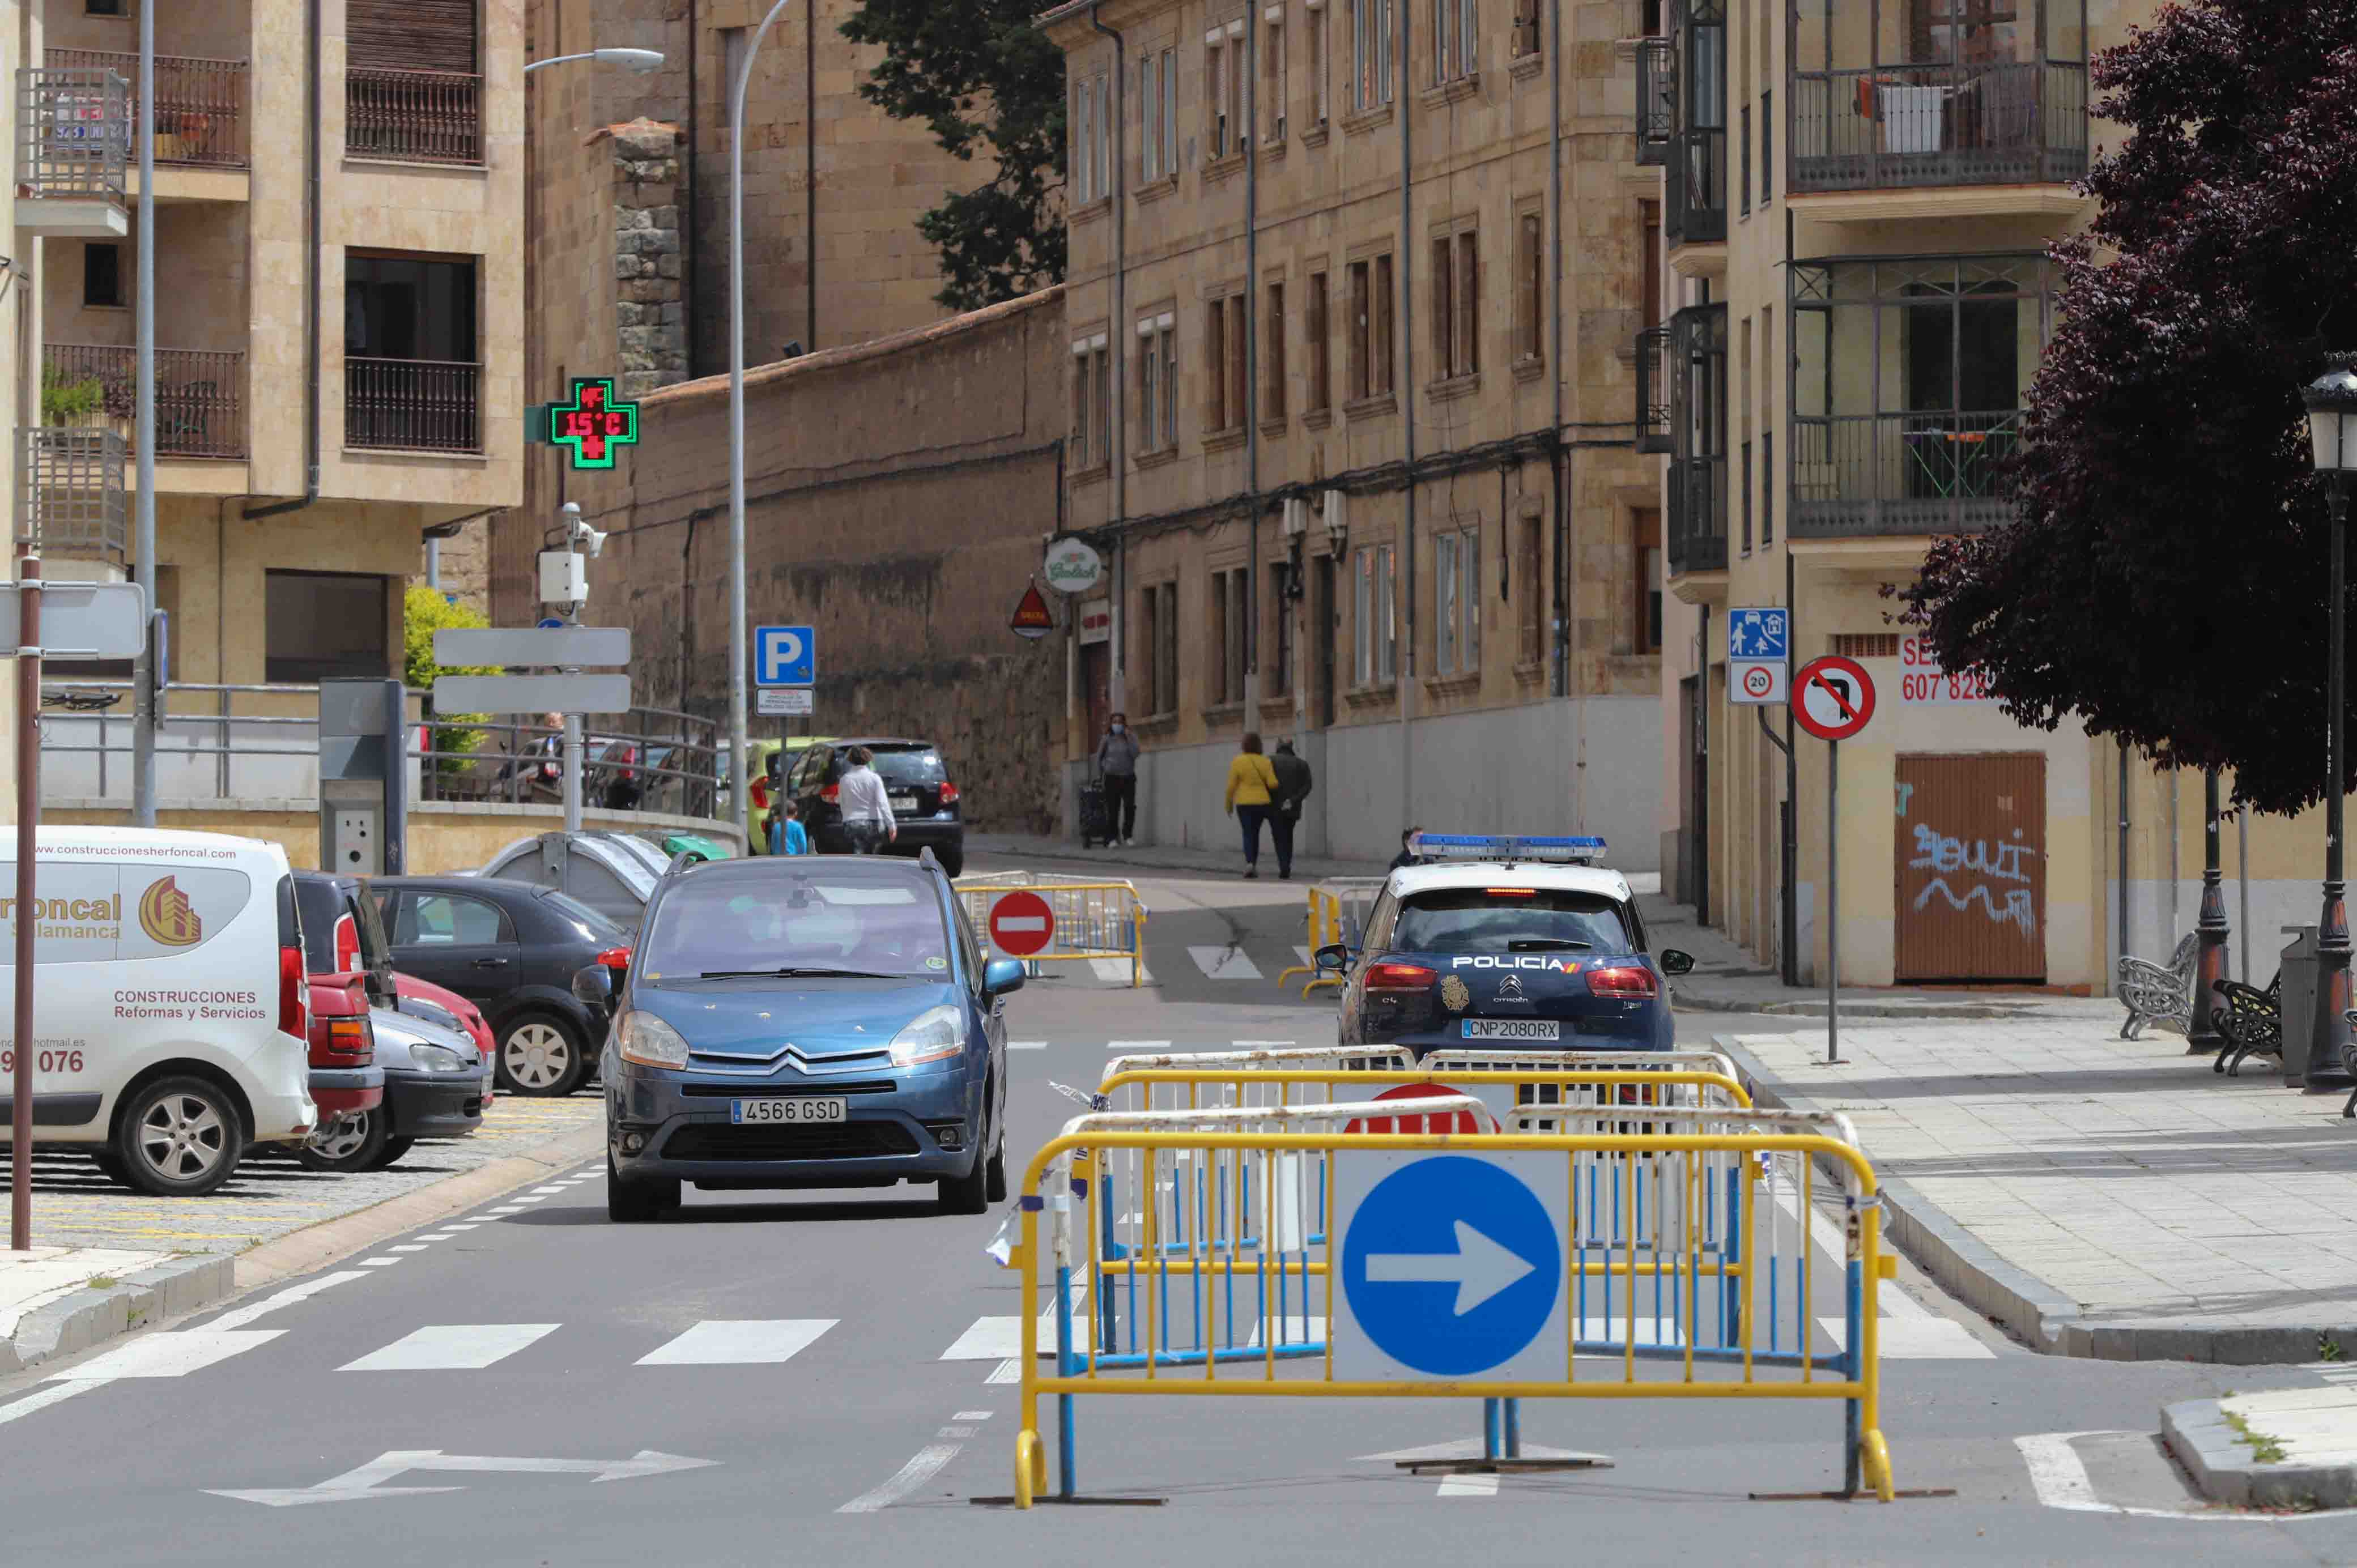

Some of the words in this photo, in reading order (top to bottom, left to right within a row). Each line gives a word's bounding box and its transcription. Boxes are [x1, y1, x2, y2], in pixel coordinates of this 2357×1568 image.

[765, 633, 803, 679] P
[1750, 676, 1766, 687] 20
[1903, 674, 1941, 700] 607
[1453, 956, 1564, 970] POLICÍA
[114, 991, 256, 1003] CONSTRUCCIONES
[114, 1006, 182, 1018] Reformas
[188, 1009, 195, 1021] y
[200, 1006, 266, 1019] Servicios
[39, 1050, 83, 1072] 076
[746, 1102, 796, 1120] 4566
[802, 1101, 840, 1119] GSD
